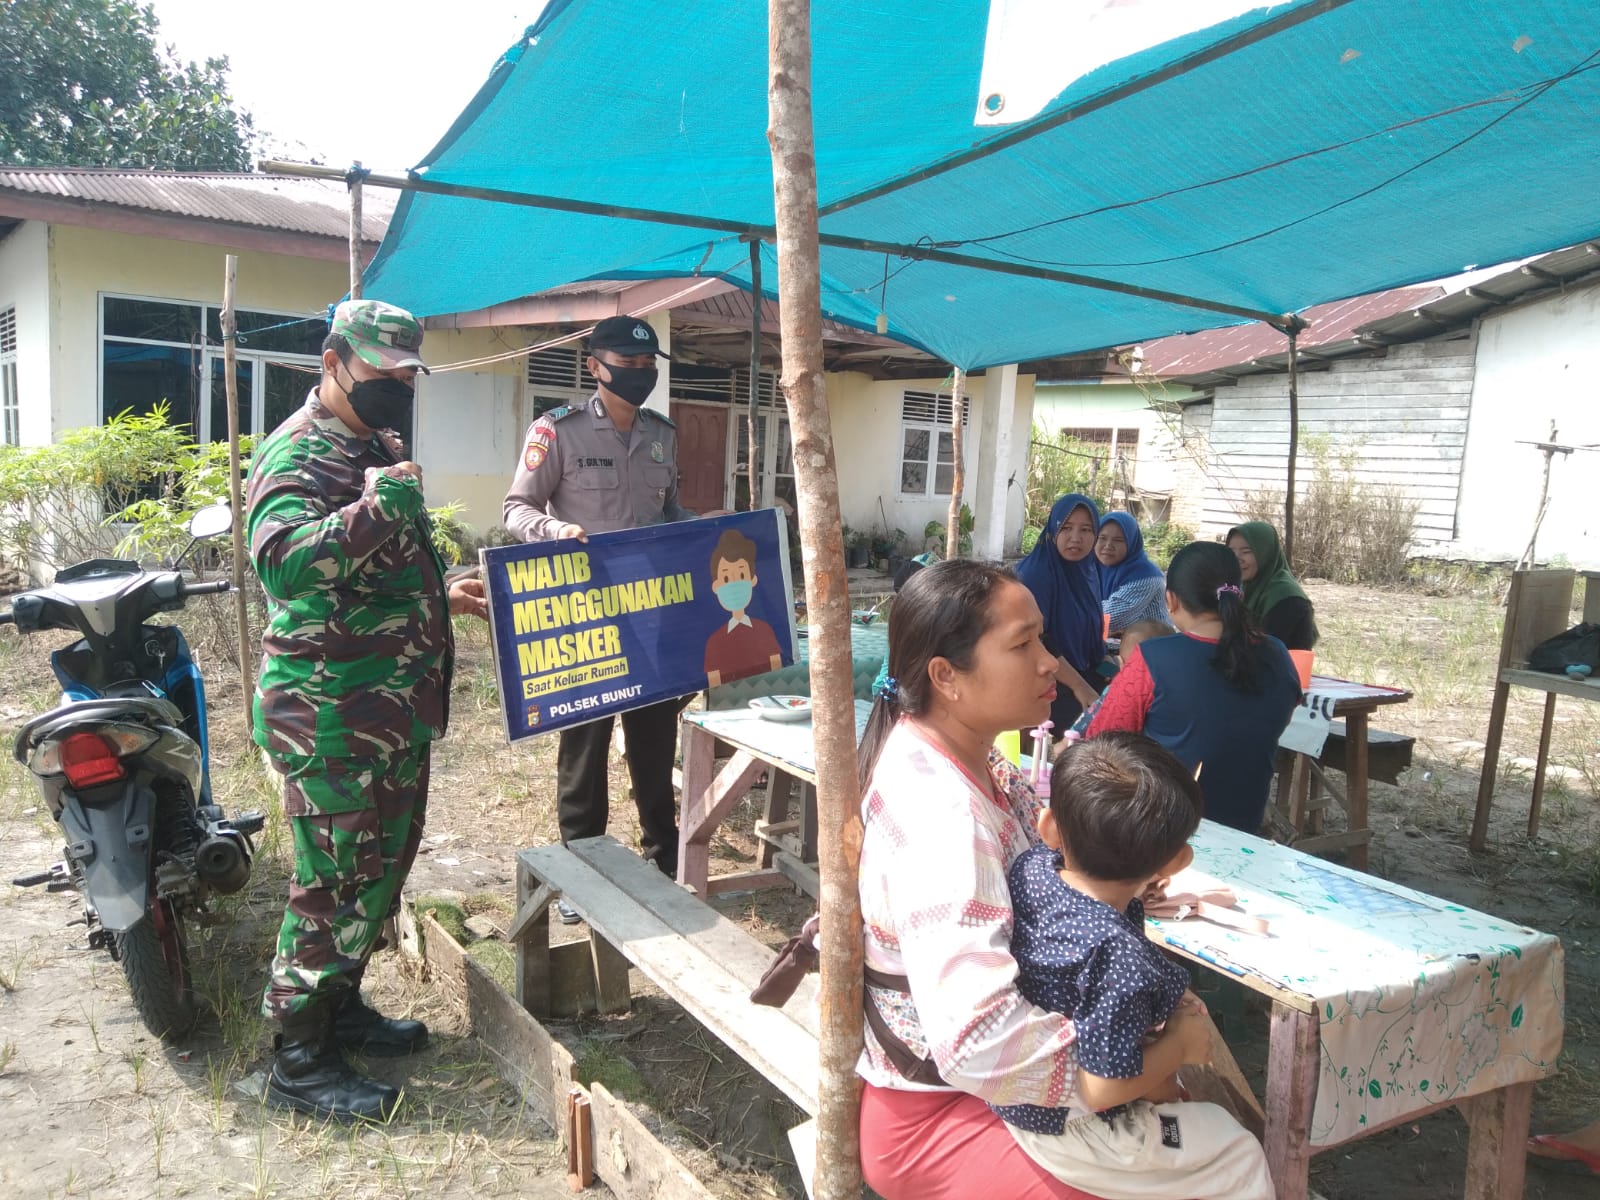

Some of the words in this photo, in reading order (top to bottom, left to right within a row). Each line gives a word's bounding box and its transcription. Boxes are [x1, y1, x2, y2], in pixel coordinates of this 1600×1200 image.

[505, 551, 591, 594] WAJIB
[512, 571, 694, 635] MENGGUNAKAN
[517, 624, 622, 676] MASKER
[526, 682, 551, 695] Saat
[553, 671, 588, 688] Keluar
[591, 662, 626, 679] Rumah
[549, 695, 600, 718] POLSEK
[601, 684, 643, 704] BUNUT
